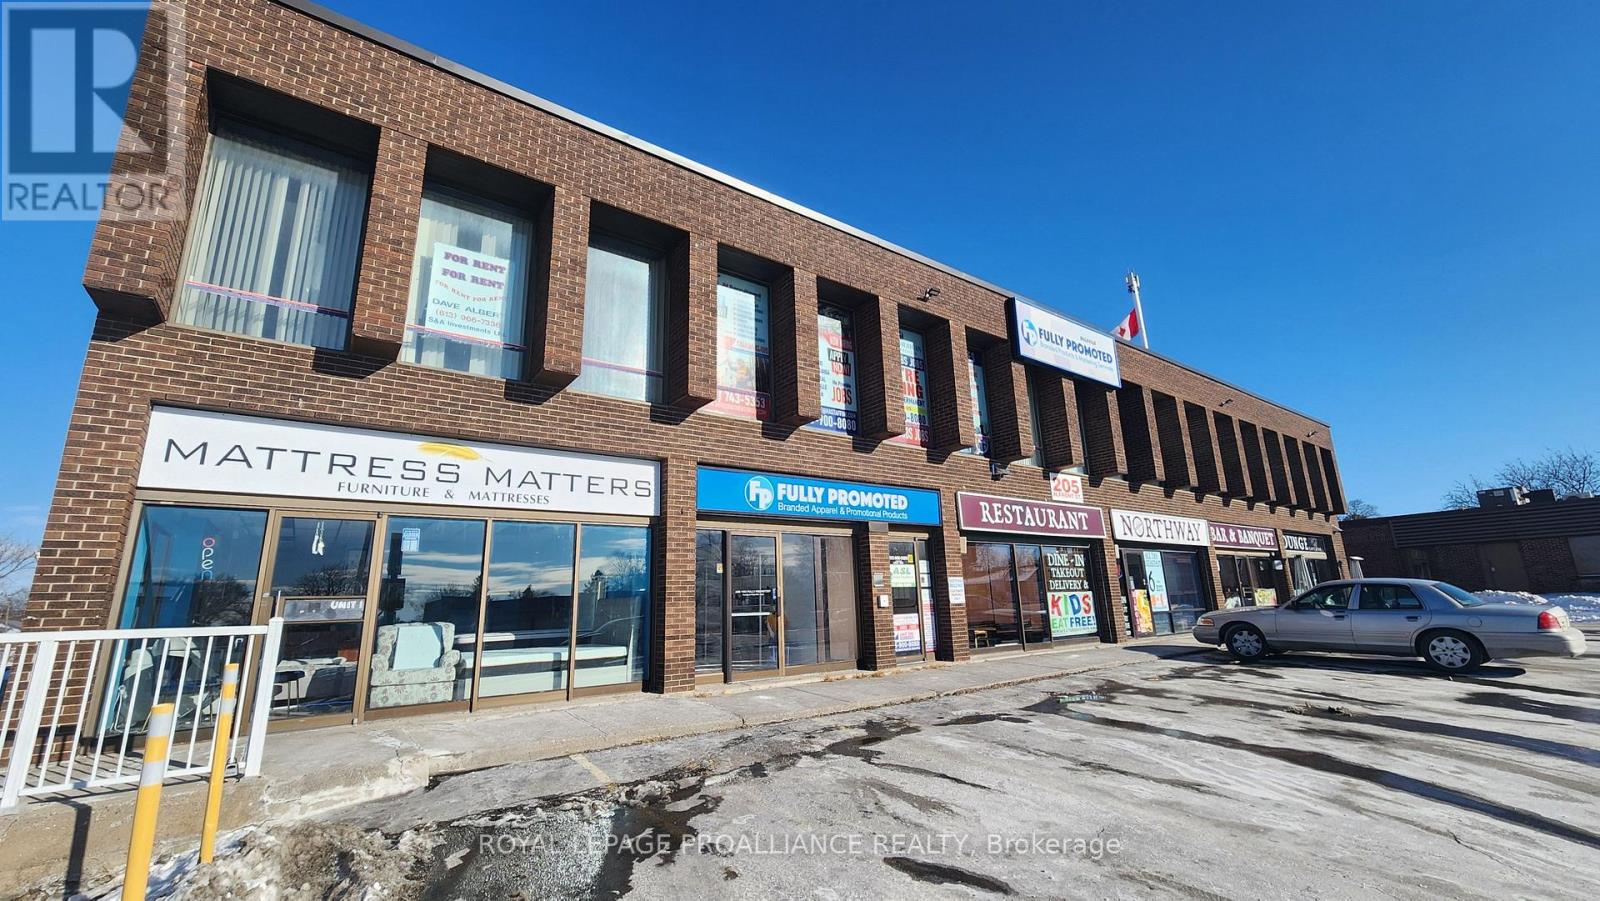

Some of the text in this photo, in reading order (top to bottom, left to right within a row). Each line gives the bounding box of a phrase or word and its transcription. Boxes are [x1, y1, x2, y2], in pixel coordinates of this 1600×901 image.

[443, 251, 506, 274] FOR RENT
[441, 267, 504, 290] FOR RENT
[432, 298, 501, 318] DAVE ALBER
[448, 320, 491, 335] Investments
[1038, 327, 1065, 348] FULLY
[1066, 339, 1113, 364] PROMOTED
[829, 350, 848, 363] APPLY
[832, 386, 853, 406] JOBS
[904, 396, 927, 408] ERMANENT
[164, 438, 651, 498] MATTRESS MATTERS
[337, 481, 550, 505] FURNITURE & MATTRESSES
[1052, 477, 1080, 495] 205
[777, 483, 908, 510] FULLY PROMOTED
[777, 502, 908, 520] Branded Apparel & Promotional Products
[979, 501, 1089, 531] RESTAURANT
[1120, 514, 1201, 542] NORTHWAY
[1209, 526, 1275, 547] BAR & BANQUET
[1282, 534, 1309, 551] OUNGE
[893, 566, 911, 575] ASL
[1050, 567, 1085, 578] TAKEOUT
[1049, 579, 1089, 590] DELIVERY &
[330, 600, 357, 610] UNIT
[1051, 593, 1092, 617] KIDS
[1051, 615, 1096, 629] EAT FREE!
